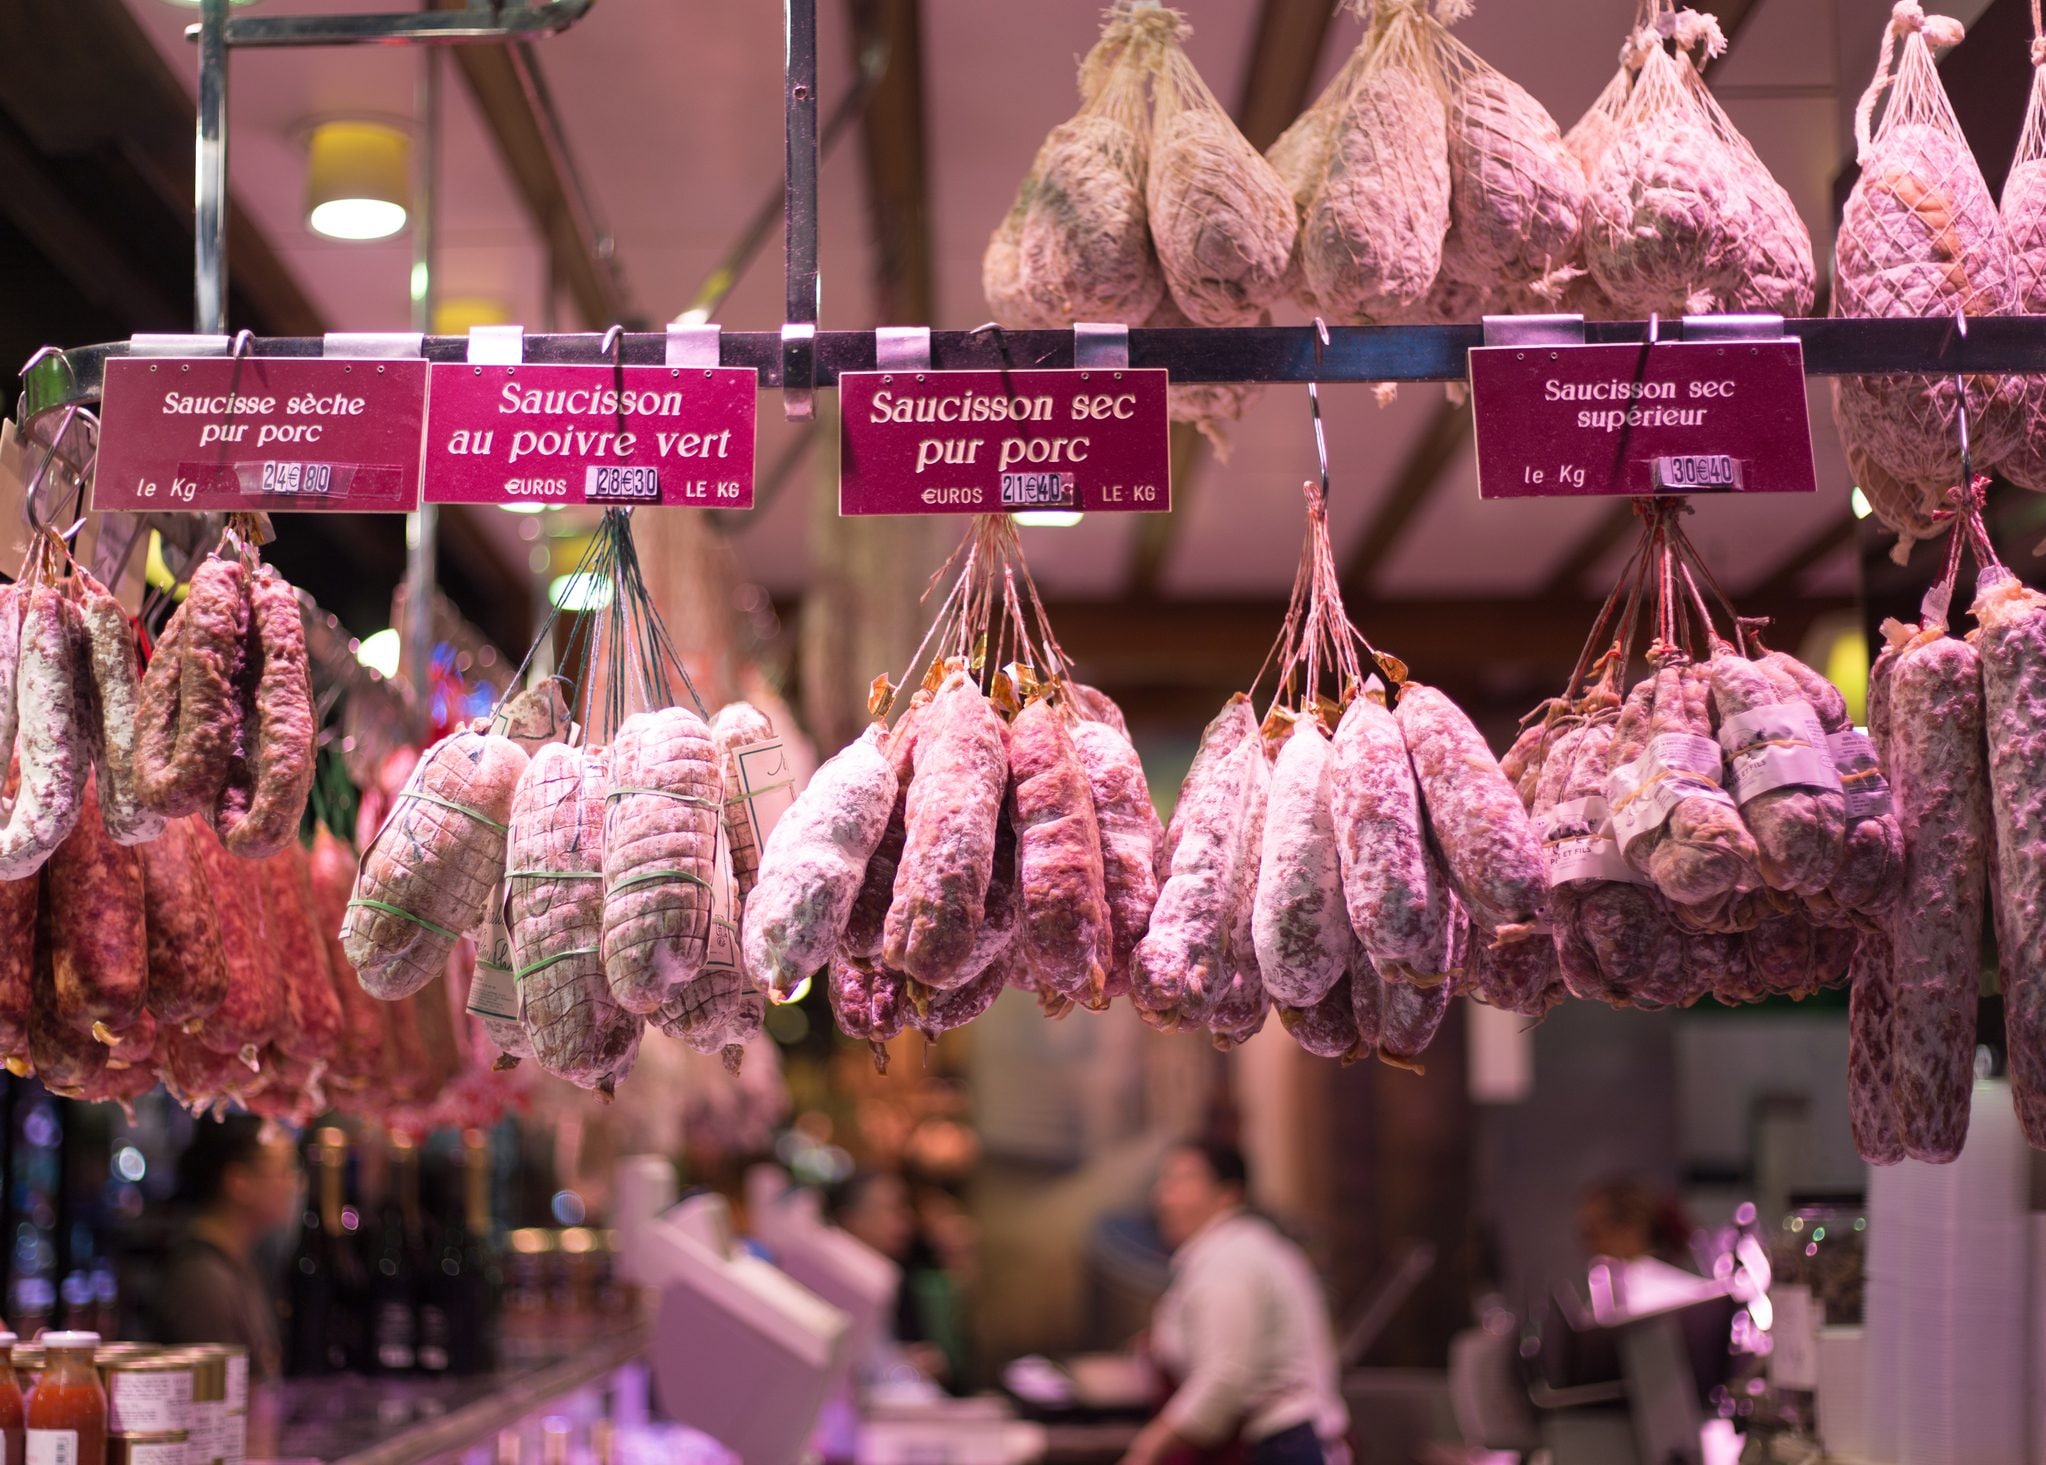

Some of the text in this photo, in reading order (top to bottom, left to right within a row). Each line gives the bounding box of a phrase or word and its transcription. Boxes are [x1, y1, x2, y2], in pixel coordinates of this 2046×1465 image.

[499, 382, 682, 416] Saucisson
[1545, 379, 1735, 401] Saucisson sec
[163, 391, 365, 415] Saucisse sèche
[870, 390, 1137, 423] Saucisson sec
[1577, 405, 1707, 432] supérieur
[199, 424, 322, 447] pur porc
[447, 425, 732, 463] au poivre vert
[915, 436, 1091, 473] pur porc
[599, 467, 656, 496] 28€30
[686, 481, 707, 498] LE
[717, 481, 740, 498] KG
[1525, 465, 1585, 487] le Kg
[136, 479, 197, 502] le Kg
[1102, 486, 1122, 501] LE
[1133, 485, 1156, 501] KG
[1563, 849, 1572, 858] ET
[1574, 847, 1592, 855] FILS
